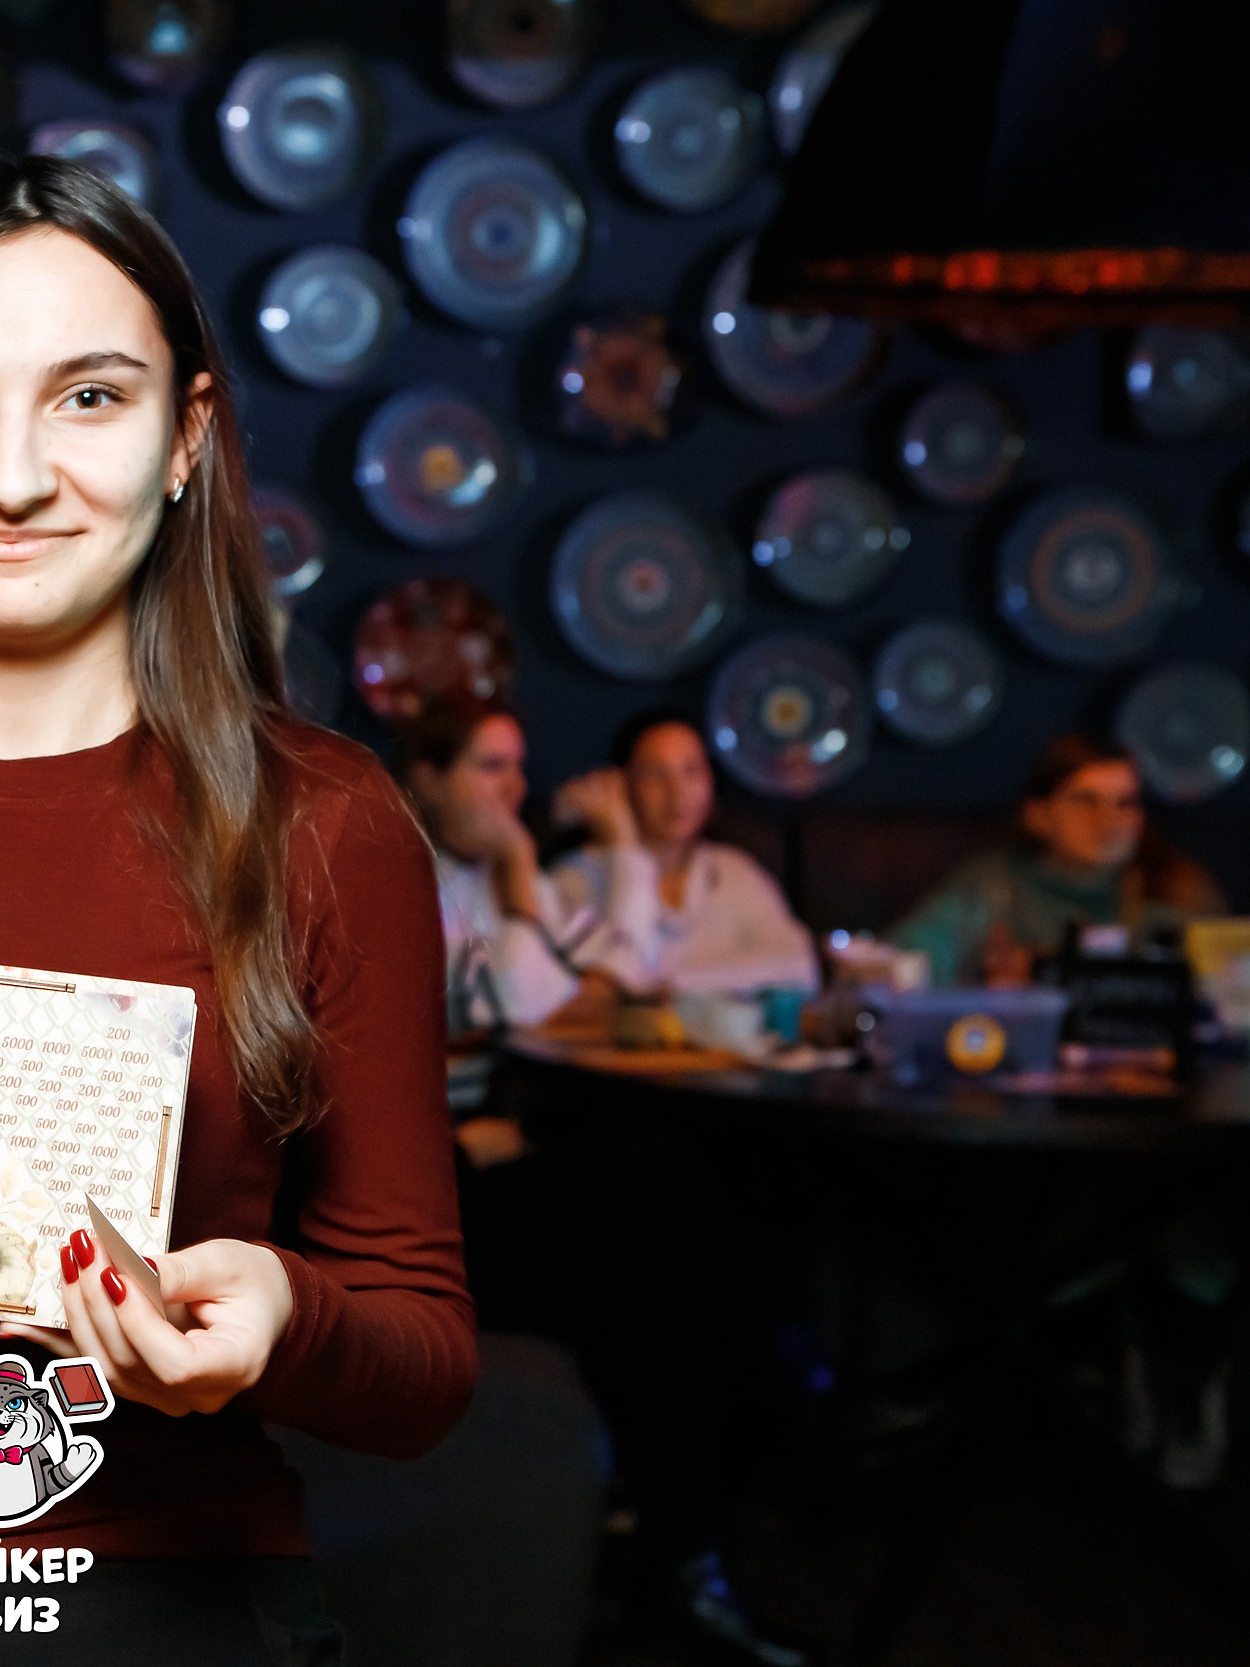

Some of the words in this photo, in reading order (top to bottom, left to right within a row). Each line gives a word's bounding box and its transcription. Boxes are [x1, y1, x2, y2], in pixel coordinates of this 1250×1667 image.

[107, 1027, 130, 1040] 200
[2, 1037, 33, 1050] 5000
[42, 1041, 71, 1055] 1000
[81, 1046, 113, 1060] 5000
[120, 1051, 149, 1064] 1000
[21, 1060, 43, 1072] 500
[60, 1066, 83, 1078] 500
[101, 1071, 123, 1083] 500
[140, 1075, 162, 1088] 500
[38, 1080, 62, 1093] 200
[78, 1084, 101, 1097] 200
[118, 1090, 142, 1103] 200
[15, 1095, 38, 1107] 500
[56, 1100, 78, 1112] 500
[98, 1105, 120, 1118] 500
[136, 1110, 158, 1122] 500
[35, 1118, 57, 1130] 500
[75, 1123, 97, 1135] 500
[117, 1128, 138, 1140] 500
[10, 1135, 37, 1148] 1000
[51, 1141, 80, 1154] 5000
[91, 1146, 118, 1159] 1000
[31, 1159, 53, 1172] 500
[70, 1164, 93, 1177] 500
[110, 1169, 132, 1181] 500
[48, 1179, 71, 1192] 200
[88, 1184, 111, 1196] 200
[105, 1208, 132, 1221] 5000
[38, 1225, 65, 1238] 1000
